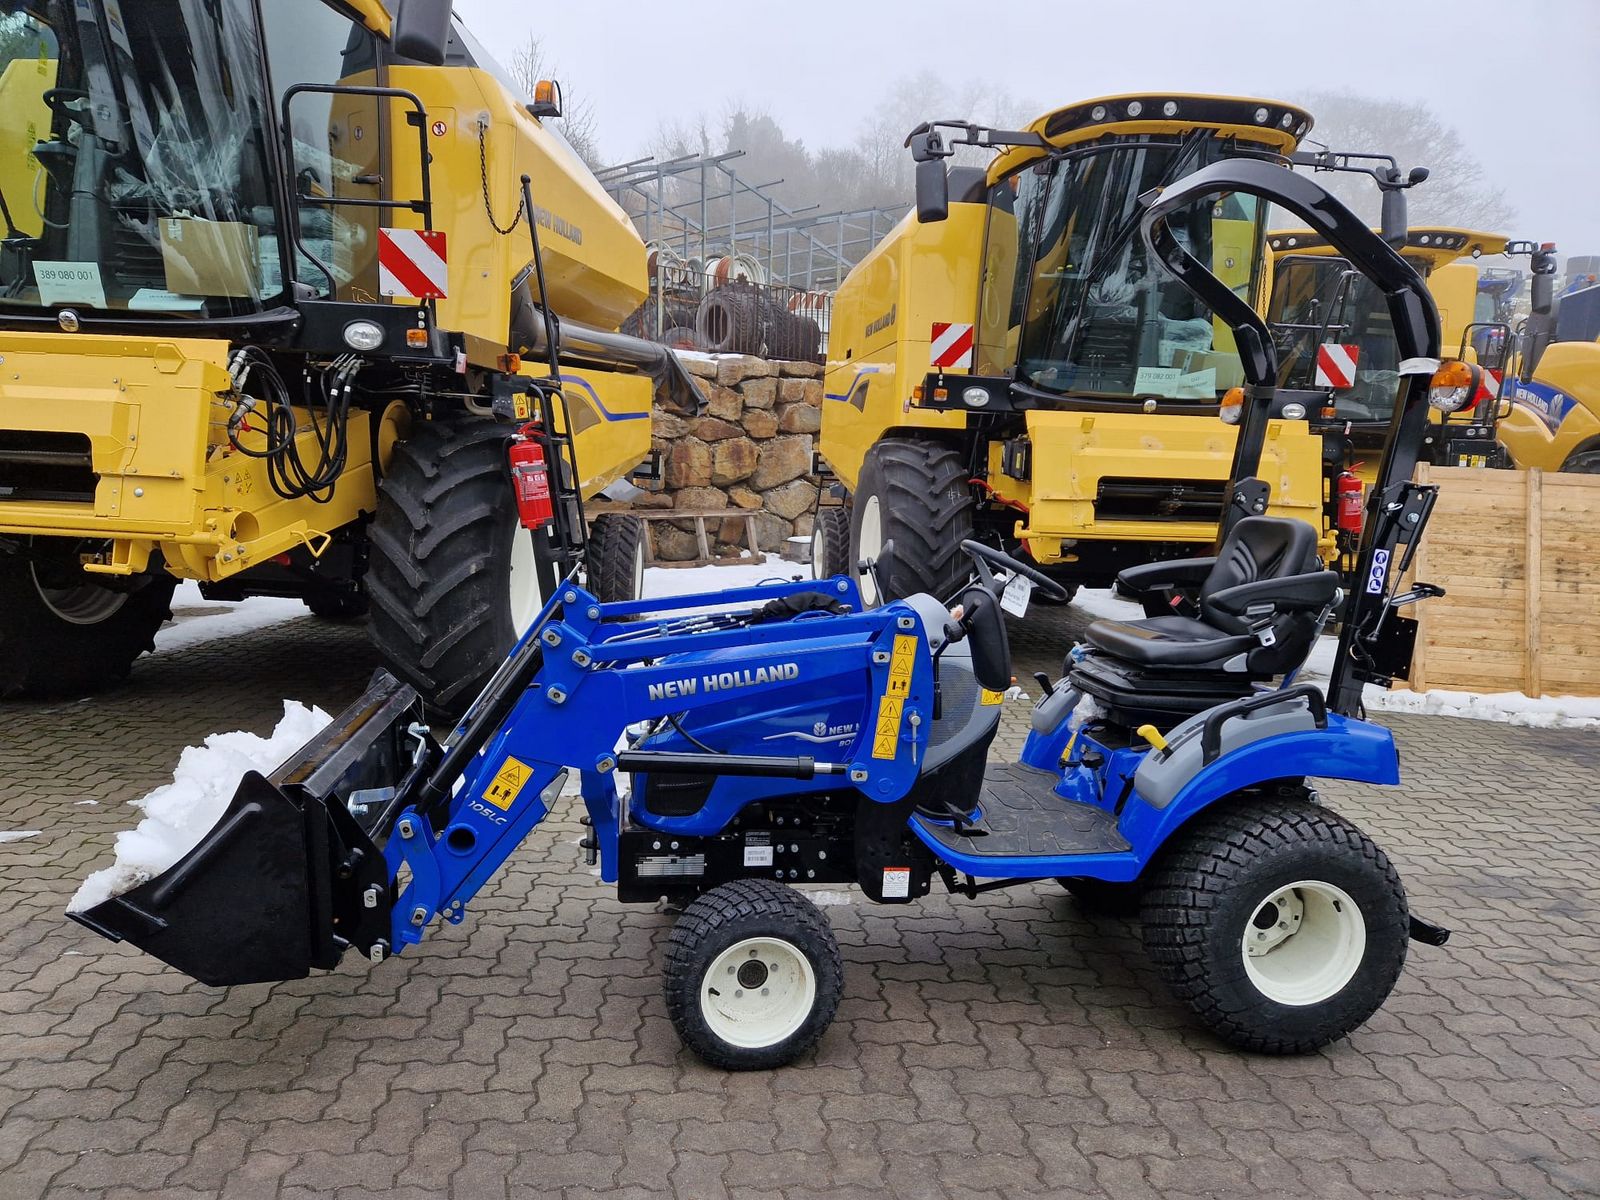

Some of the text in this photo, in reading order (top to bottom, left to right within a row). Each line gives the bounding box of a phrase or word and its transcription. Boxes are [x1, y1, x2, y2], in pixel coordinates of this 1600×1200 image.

[40, 270, 93, 281] 389 080 001
[648, 662, 799, 701] NEW HOLLAND
[829, 724, 853, 735] NEW
